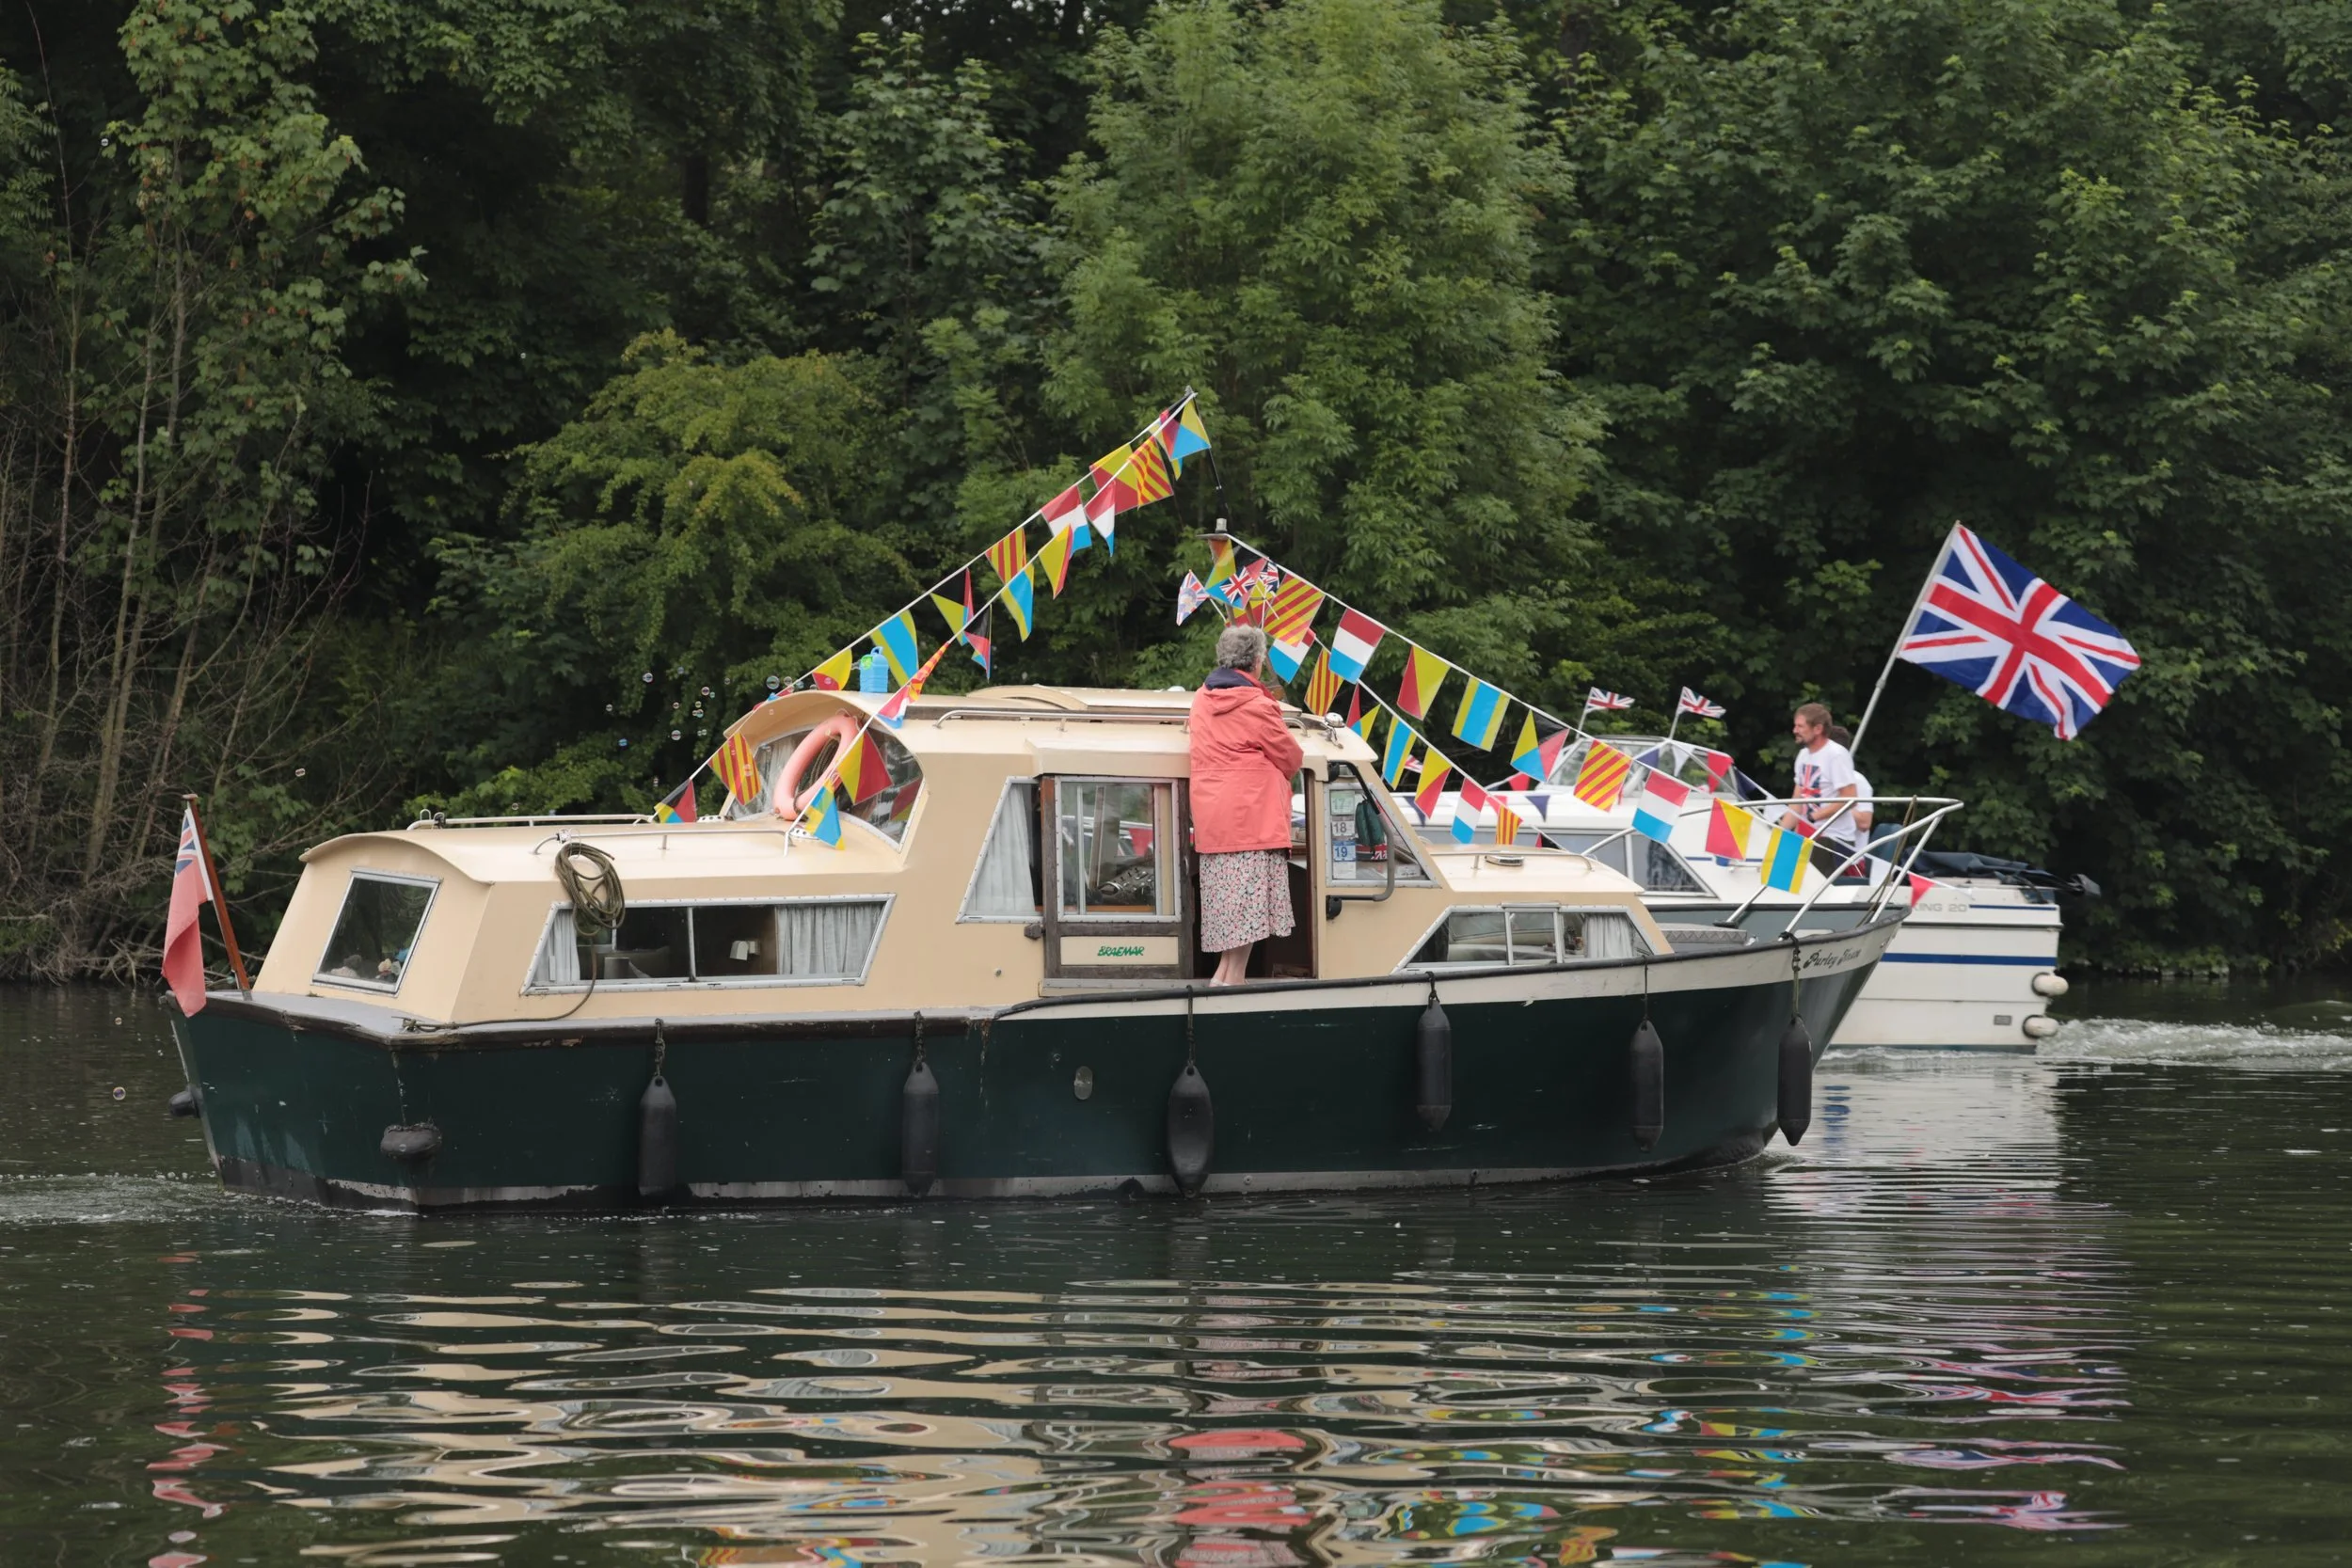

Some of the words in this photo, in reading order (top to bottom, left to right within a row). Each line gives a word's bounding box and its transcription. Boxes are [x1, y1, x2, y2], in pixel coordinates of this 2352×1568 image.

[1333, 821, 1347, 833] 18
[1334, 846, 1348, 858] 19
[1948, 903, 1967, 912] 20
[1097, 945, 1145, 958] BRAEMAR
